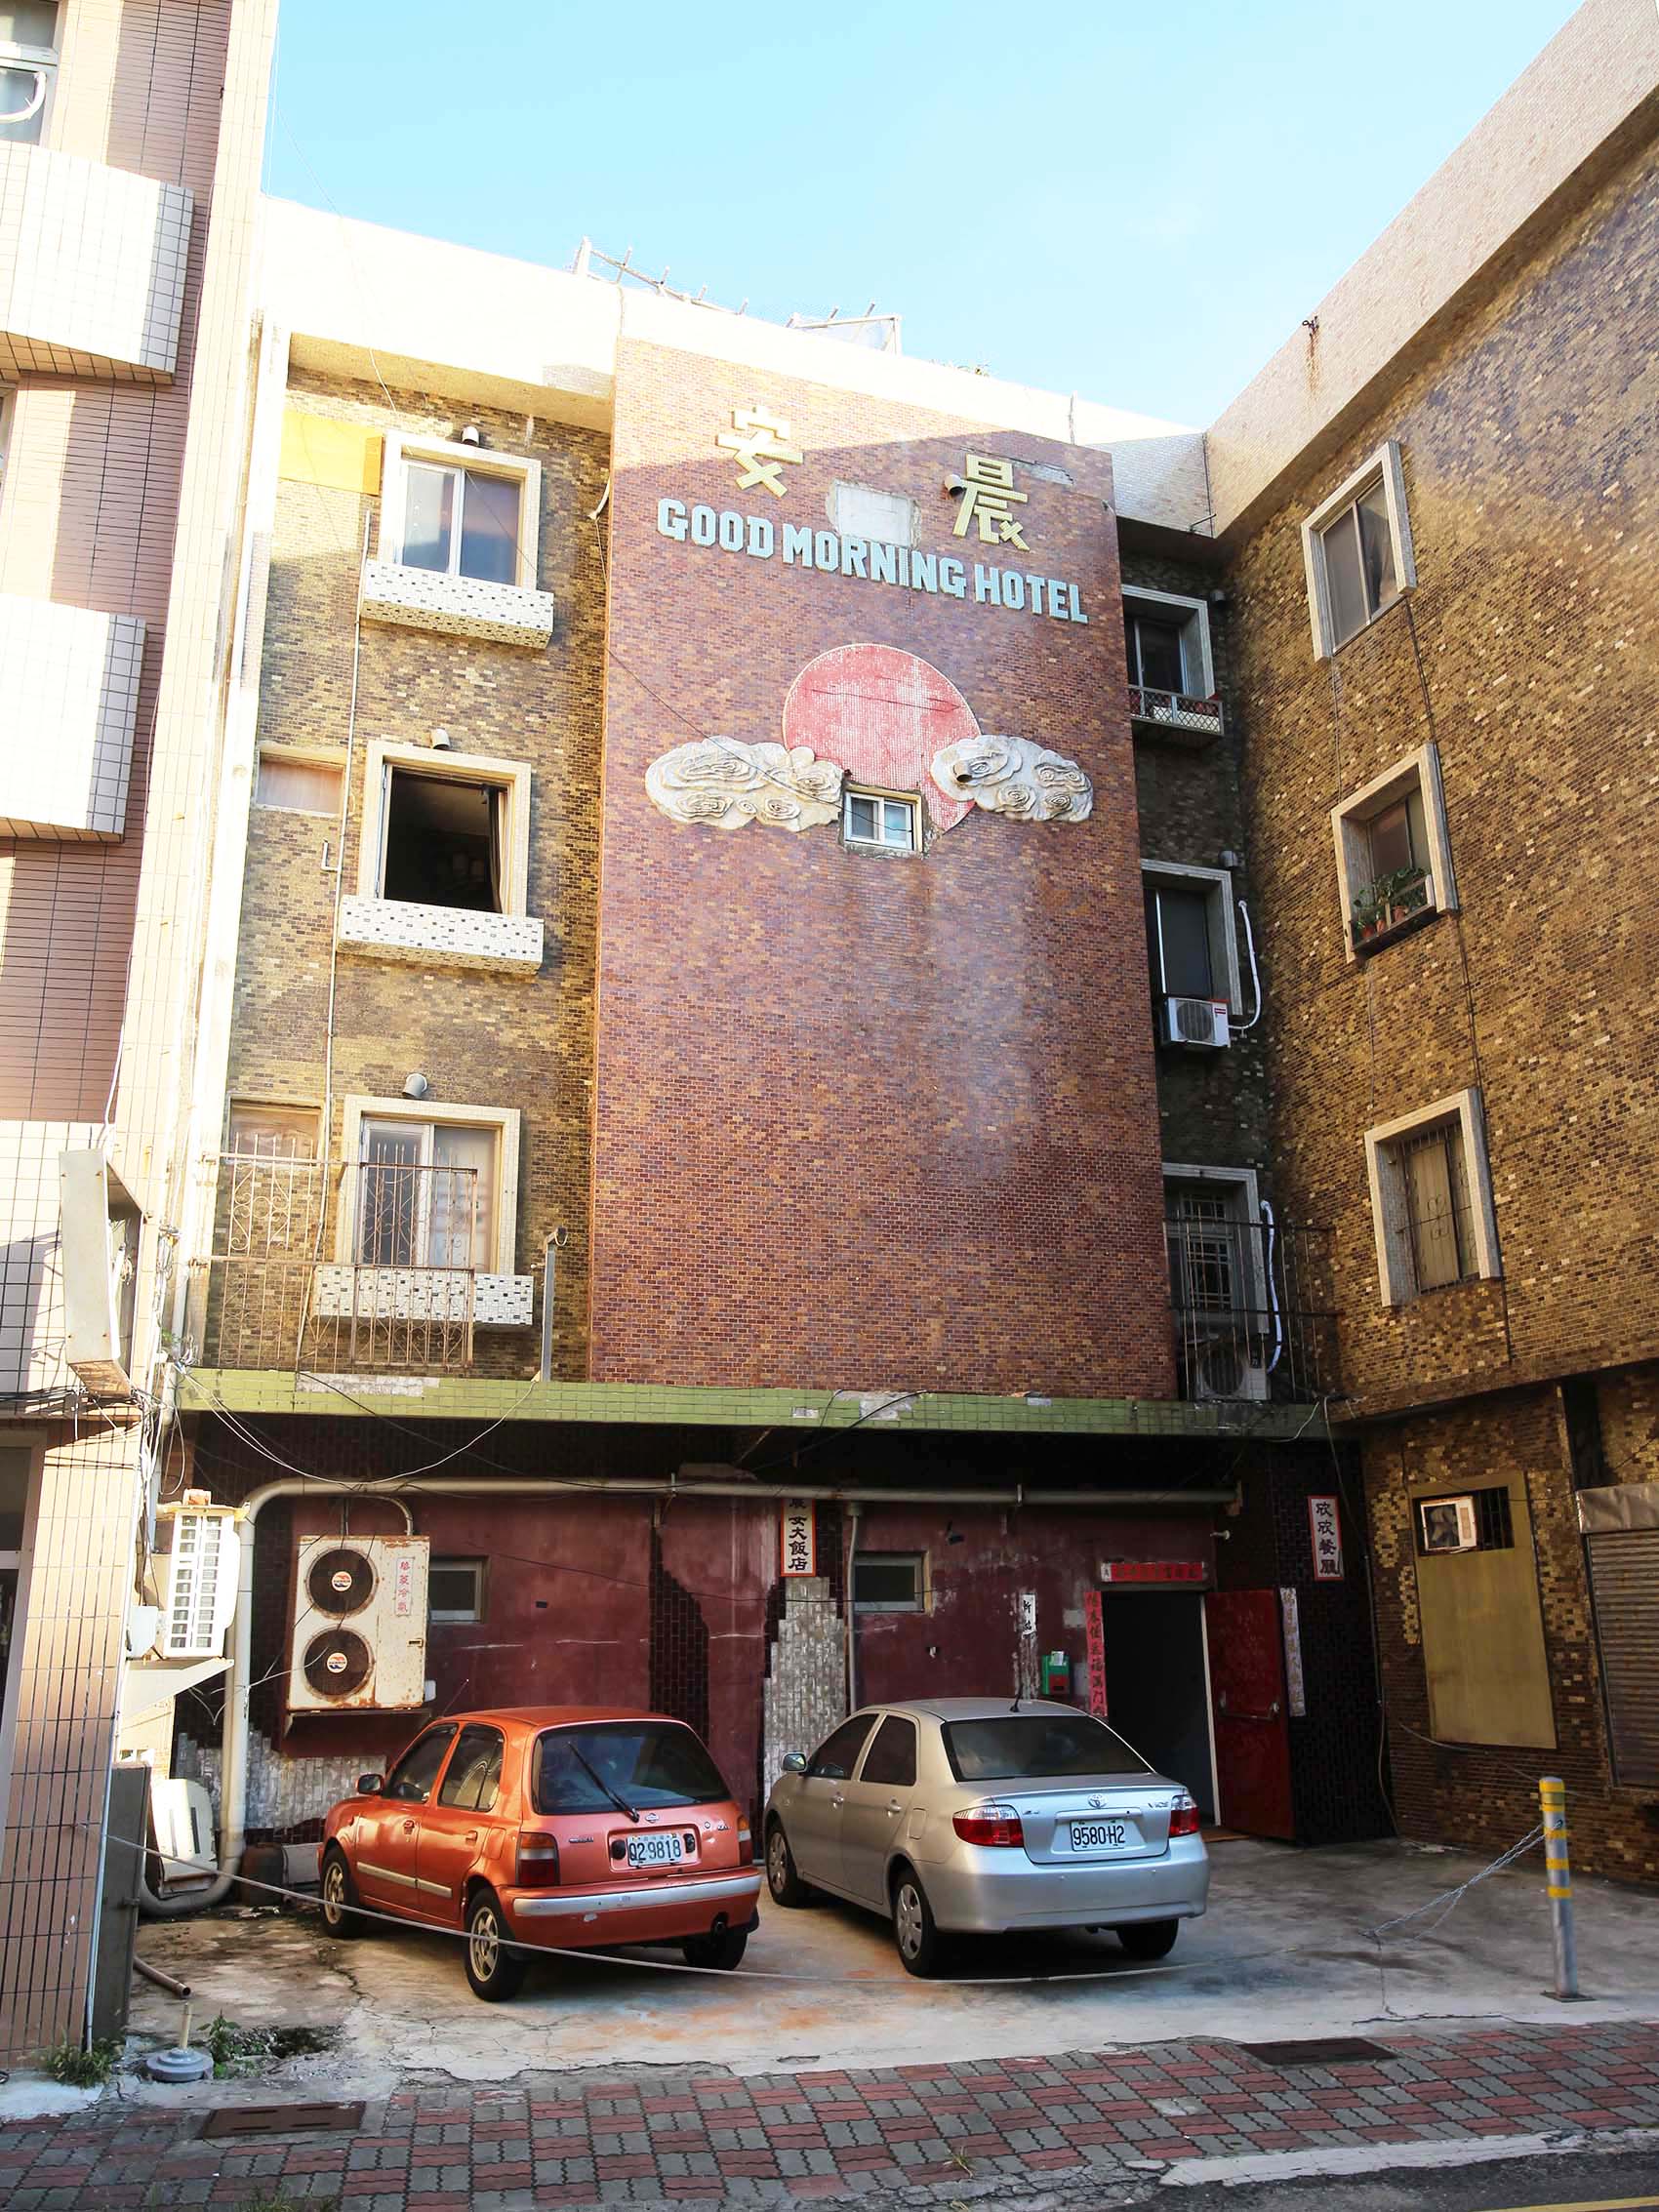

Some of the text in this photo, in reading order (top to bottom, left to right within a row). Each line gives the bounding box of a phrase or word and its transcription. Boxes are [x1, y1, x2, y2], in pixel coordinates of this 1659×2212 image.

[716, 406, 1030, 551] 安 晨
[658, 498, 1089, 624] GOOD MORNING HOTEL
